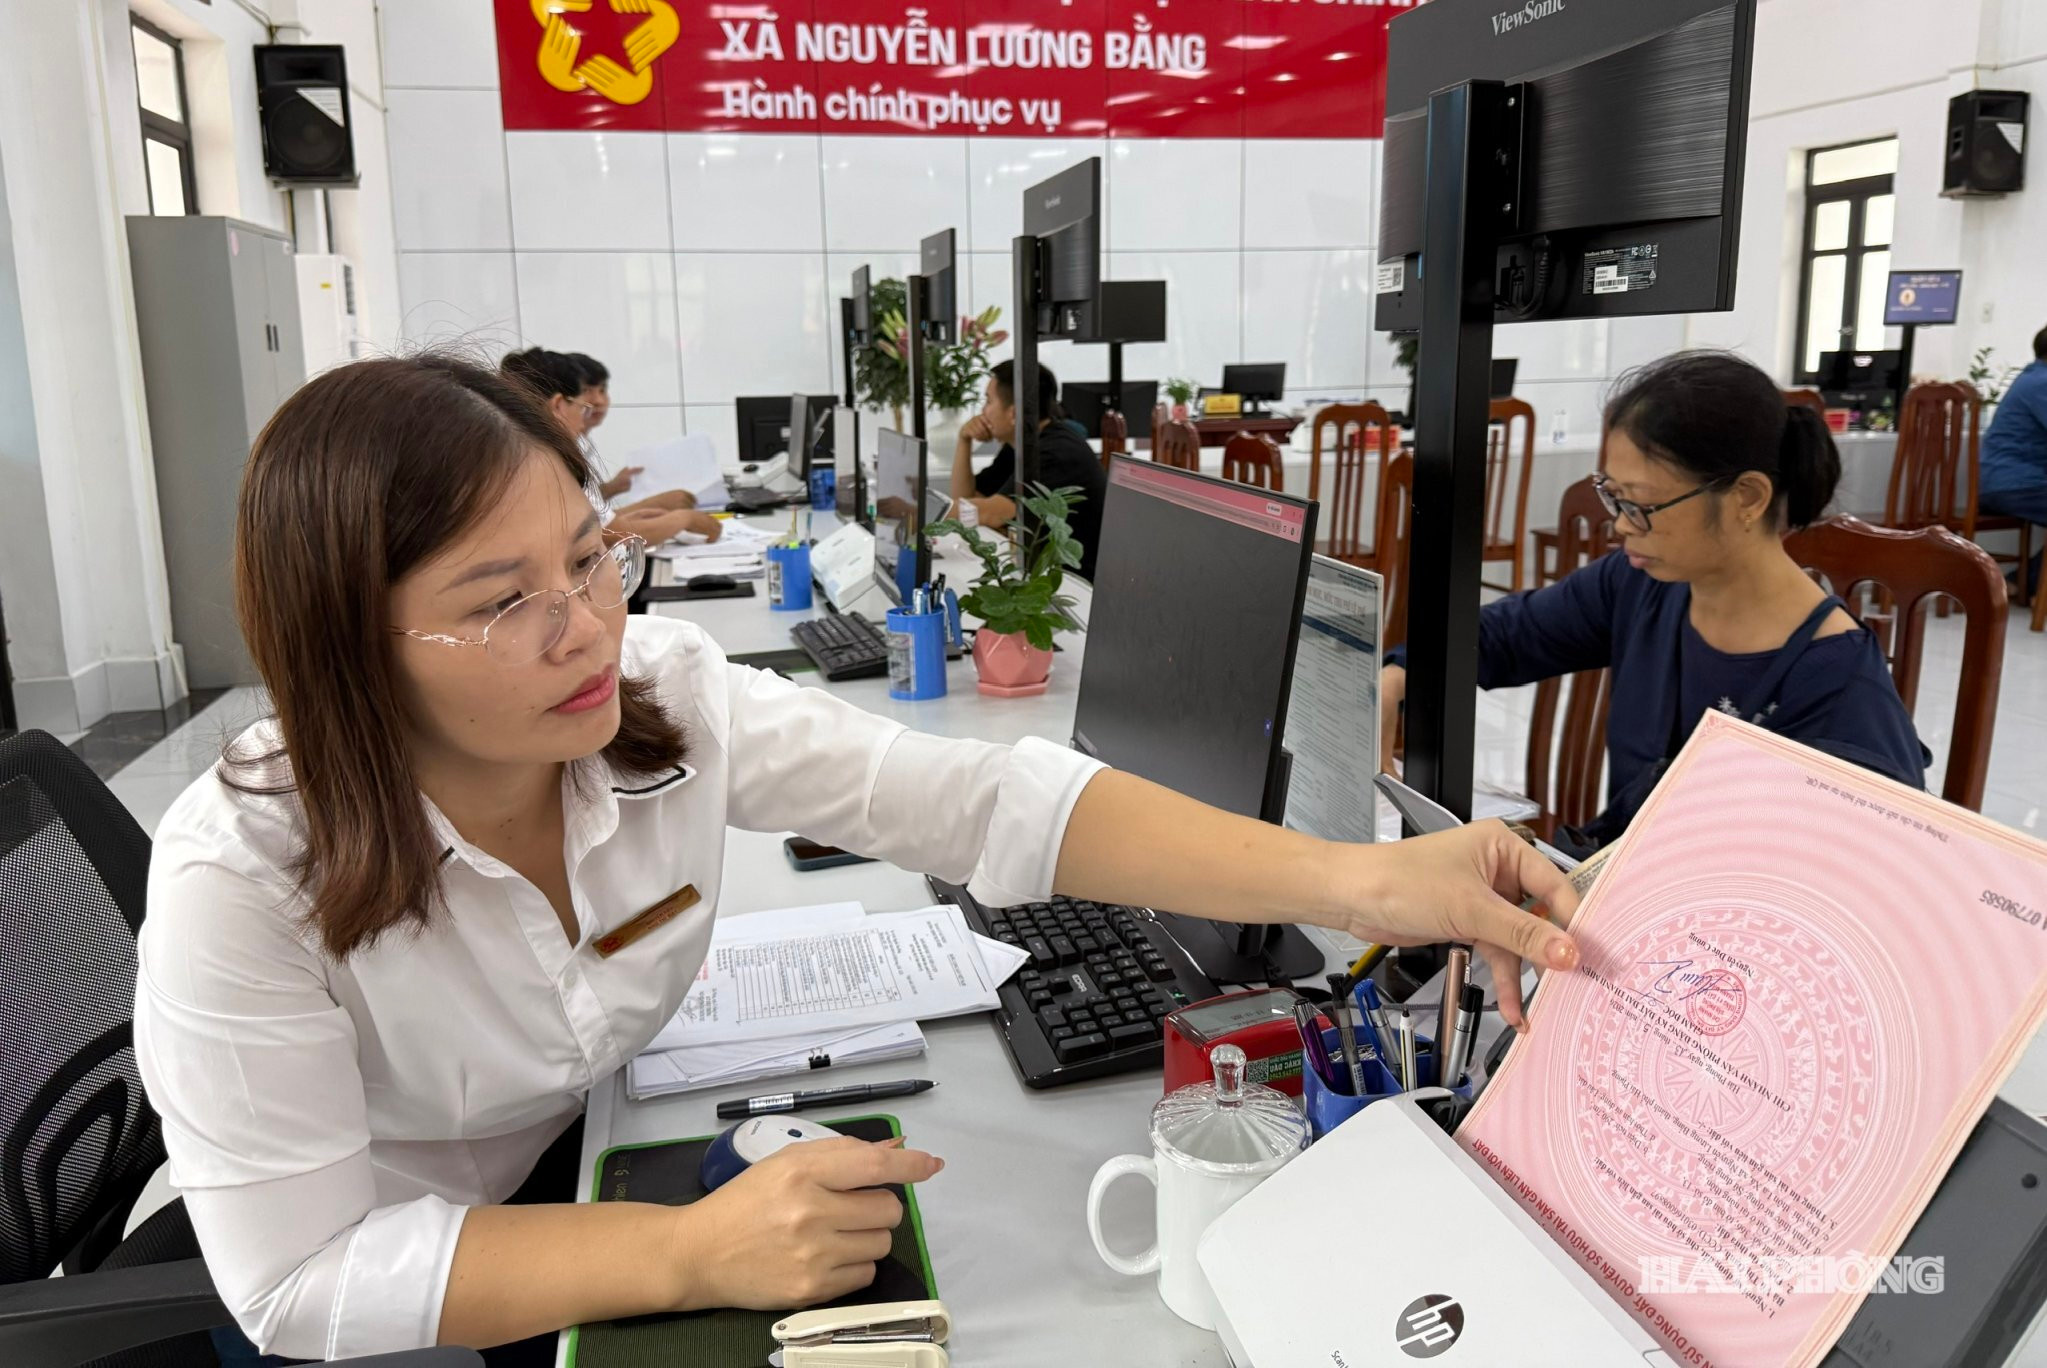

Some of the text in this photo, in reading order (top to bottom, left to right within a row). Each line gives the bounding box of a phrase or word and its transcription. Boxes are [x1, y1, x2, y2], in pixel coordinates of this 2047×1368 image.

[720, 8, 1206, 71] XÃ NGUYỄN LƯƠNG BẰNG
[723, 78, 1062, 133] Hành chính phục vụ
[1979, 889, 2041, 925] 07790585
[1687, 932, 1712, 950] Cường
[1725, 955, 1754, 977] Nguyễn
[1654, 1016, 1668, 1028] KÝ
[1666, 1024, 1691, 1044] ĐĂNG
[1686, 1052, 1704, 1067] ngày
[1689, 1040, 1721, 1064] PHÒNG
[1719, 1060, 1739, 1077] VĂN
[1726, 1081, 1740, 1093] Hải
[1738, 1073, 1772, 1099] NHÁNH
[1771, 1096, 1790, 1112] CHI
[1688, 1130, 1712, 1151] Lương
[1720, 1139, 1733, 1150] với
[1710, 1147, 1739, 1171] Nguyễn
[1733, 1148, 1748, 1161] liền
[1747, 1158, 1763, 1172] gắn
[1714, 1168, 1734, 1185] dụng
[1762, 1170, 1777, 1183] sản
[1776, 1181, 1788, 1192] tài
[1788, 1190, 1800, 1201] tin
[1800, 1198, 1828, 1221] Thông
[1827, 1220, 1836, 1229] 3.
[1684, 1237, 1699, 1251] chủ
[1790, 1229, 1811, 1247] Hình
[1471, 1138, 1702, 1364] SỬ DỤNG ĐẤT, QUYỀN SỞ HỮU TÀI SẢN GẮN LIỀN VỚI ĐẤT
[1712, 1260, 1734, 1280] dụng
[1330, 1349, 1350, 1368] Scan
